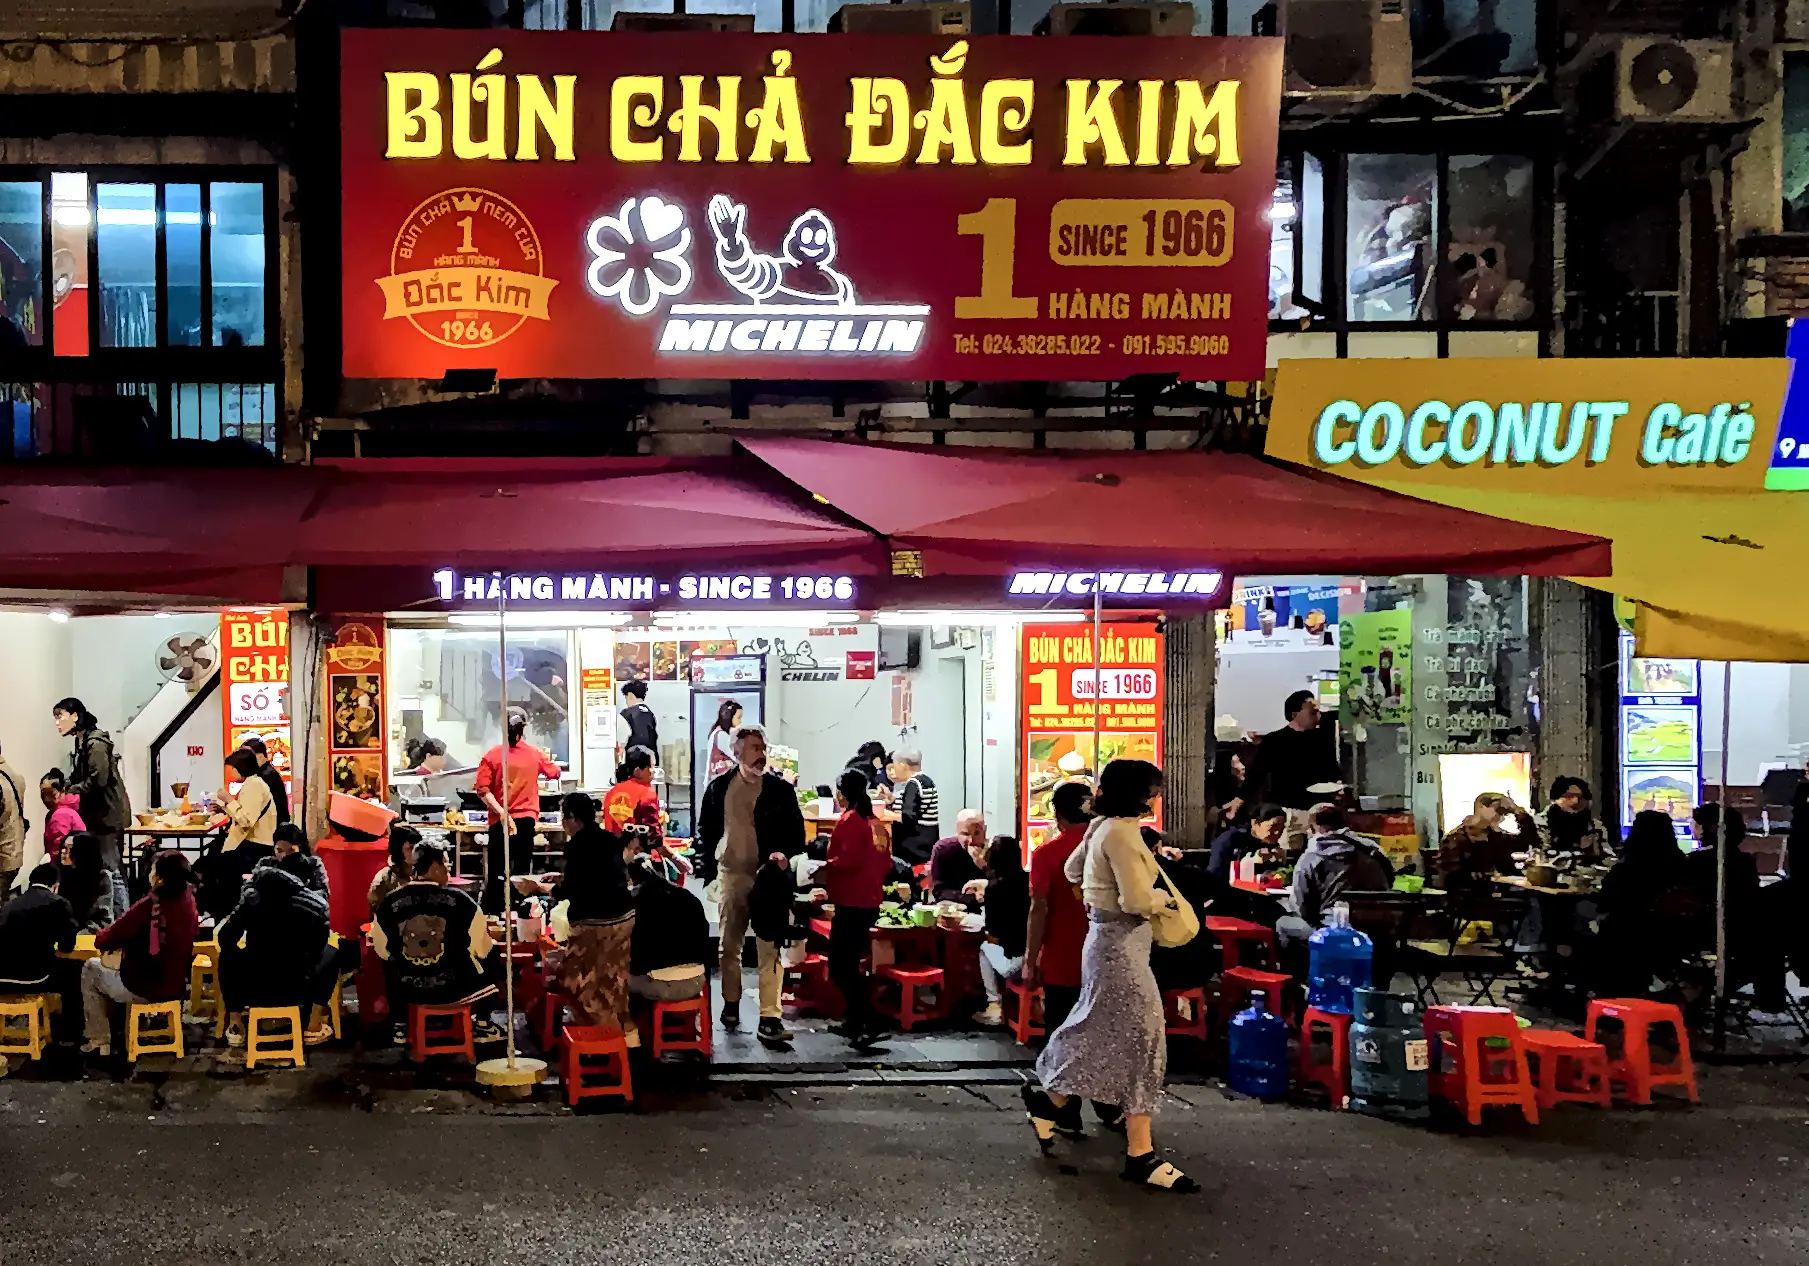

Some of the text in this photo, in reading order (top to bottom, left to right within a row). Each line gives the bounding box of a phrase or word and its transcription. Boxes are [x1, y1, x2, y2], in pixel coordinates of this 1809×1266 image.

[384, 39, 1242, 167] BÚN CHẢ ĐẮC KIM
[483, 201, 517, 229] NEM
[456, 215, 478, 253] 1
[1057, 209, 1226, 257] SINCE 1966
[954, 197, 1039, 320] 1
[475, 274, 531, 309] Kim
[1049, 287, 1232, 320] HÀNG MÀNH
[440, 320, 494, 342] 1966
[658, 319, 924, 352] MICHELIN
[953, 333, 979, 355] Tel:
[1314, 400, 1756, 465] COCONUT Café
[433, 569, 454, 601] 1
[678, 575, 772, 600] SINCE
[780, 576, 853, 600] 1966
[1008, 571, 1223, 594] MICHELIN
[1029, 631, 1060, 663] BÚN
[1063, 628, 1093, 664] CHẢ
[1128, 637, 1156, 663] KIM
[241, 686, 269, 711] SỐ
[1028, 668, 1070, 715] 1
[1114, 673, 1152, 694] 1966
[187, 746, 204, 757] KHO
